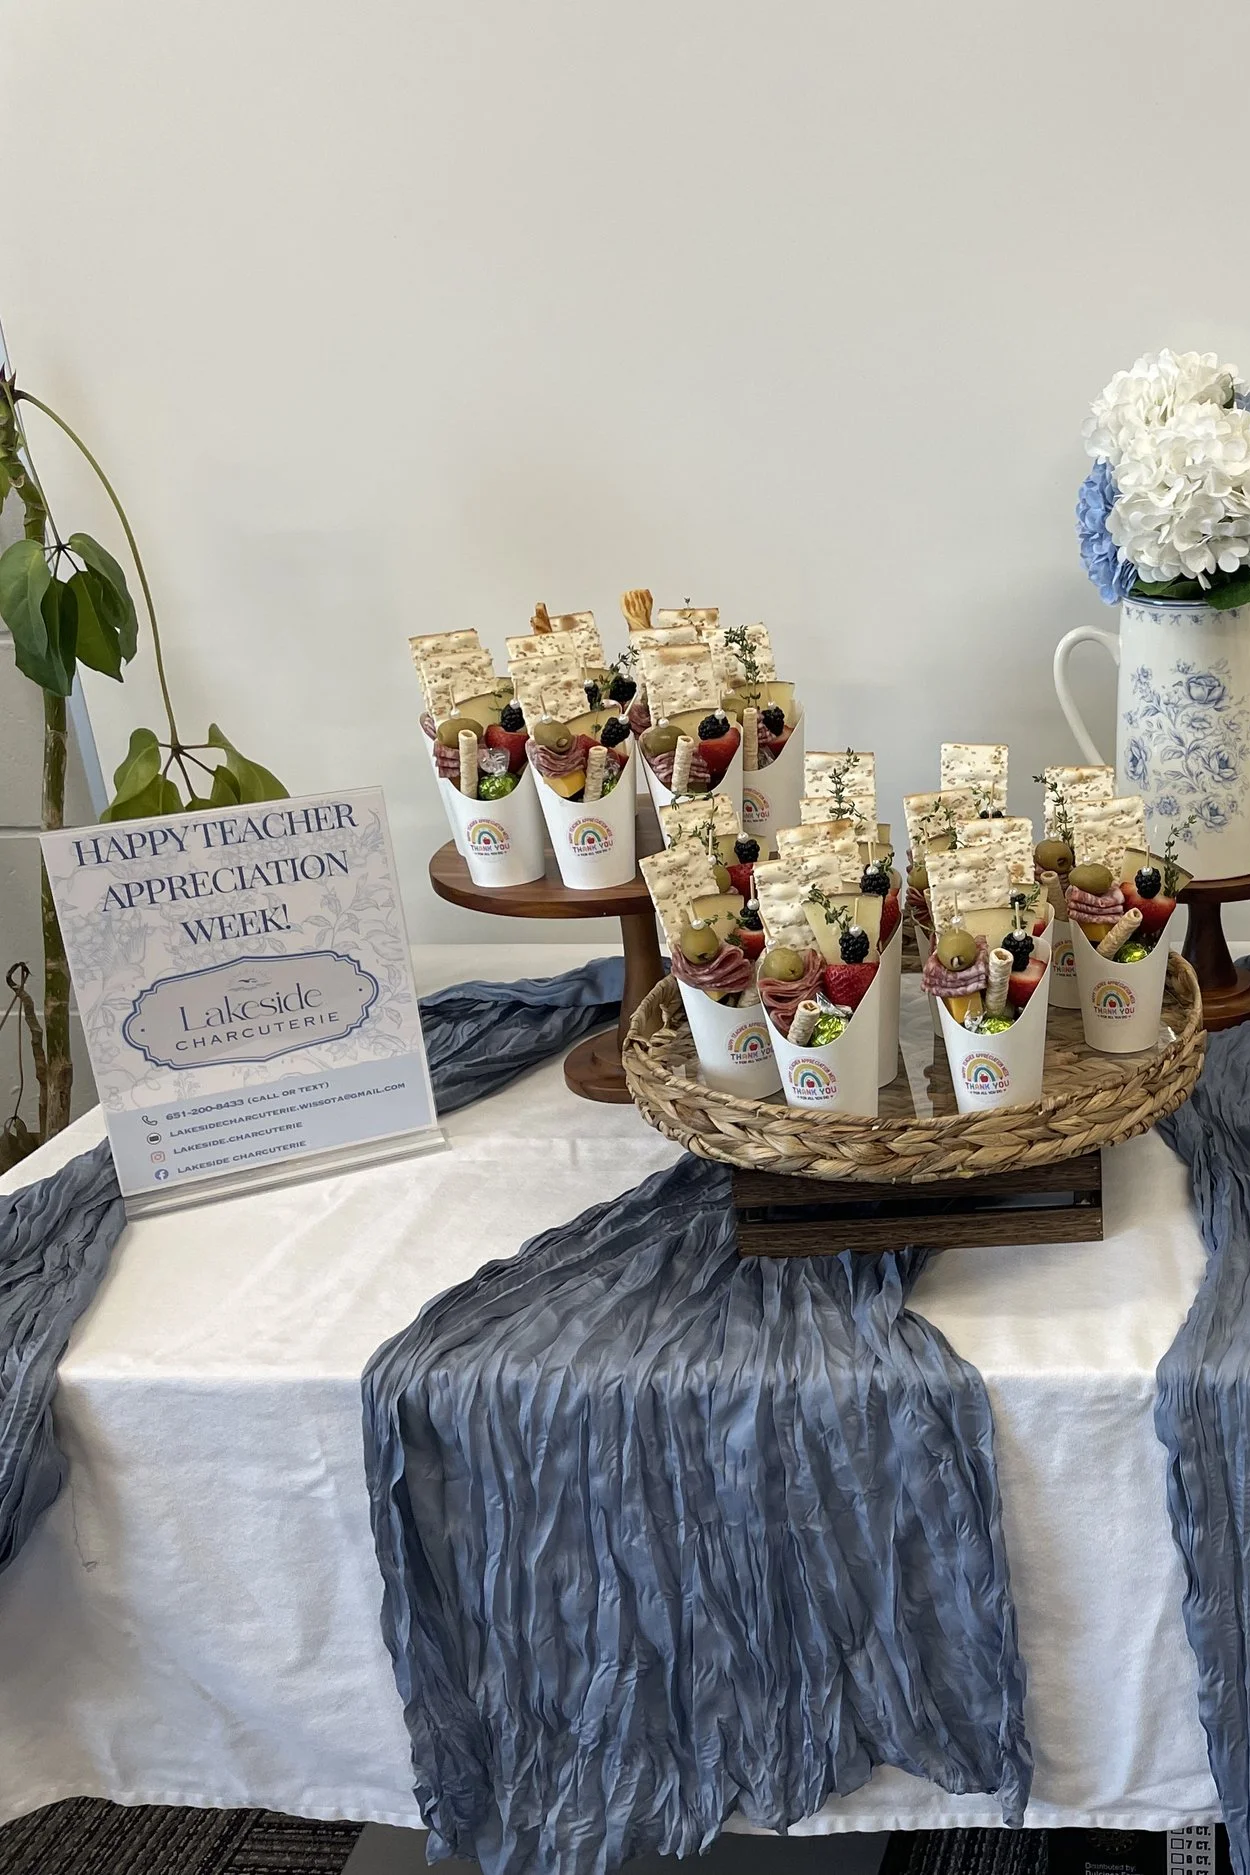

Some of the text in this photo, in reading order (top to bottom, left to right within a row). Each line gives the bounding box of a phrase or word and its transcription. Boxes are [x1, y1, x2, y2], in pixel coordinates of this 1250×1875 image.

[73, 804, 358, 867] HAPPY TEACHER
[102, 850, 350, 911] APPRECIATION
[181, 904, 293, 944] WEEK!
[179, 983, 324, 1031] Lakeside
[175, 1012, 339, 1051] CHARCUTERIE
[730, 1052, 758, 1060] THANK
[166, 1081, 329, 1121] 651-200-8433 (CALL OR TEXT)
[792, 1086, 837, 1096] THANK YOU
[965, 1080, 1009, 1090] THANK YOU
[170, 1082, 405, 1137] LAKESIDECHARCUTERIE.WISSOTA@GMAIL.COM
[173, 1122, 303, 1154] LAKESIDE.CHARCUTERIE
[177, 1141, 306, 1174] LAKESIDE CHARCUTERIE
[1186, 1840, 1211, 1850] 7 CT.
[1196, 1826, 1211, 1835] CT.
[1186, 1855, 1211, 1865] 8 CT.
